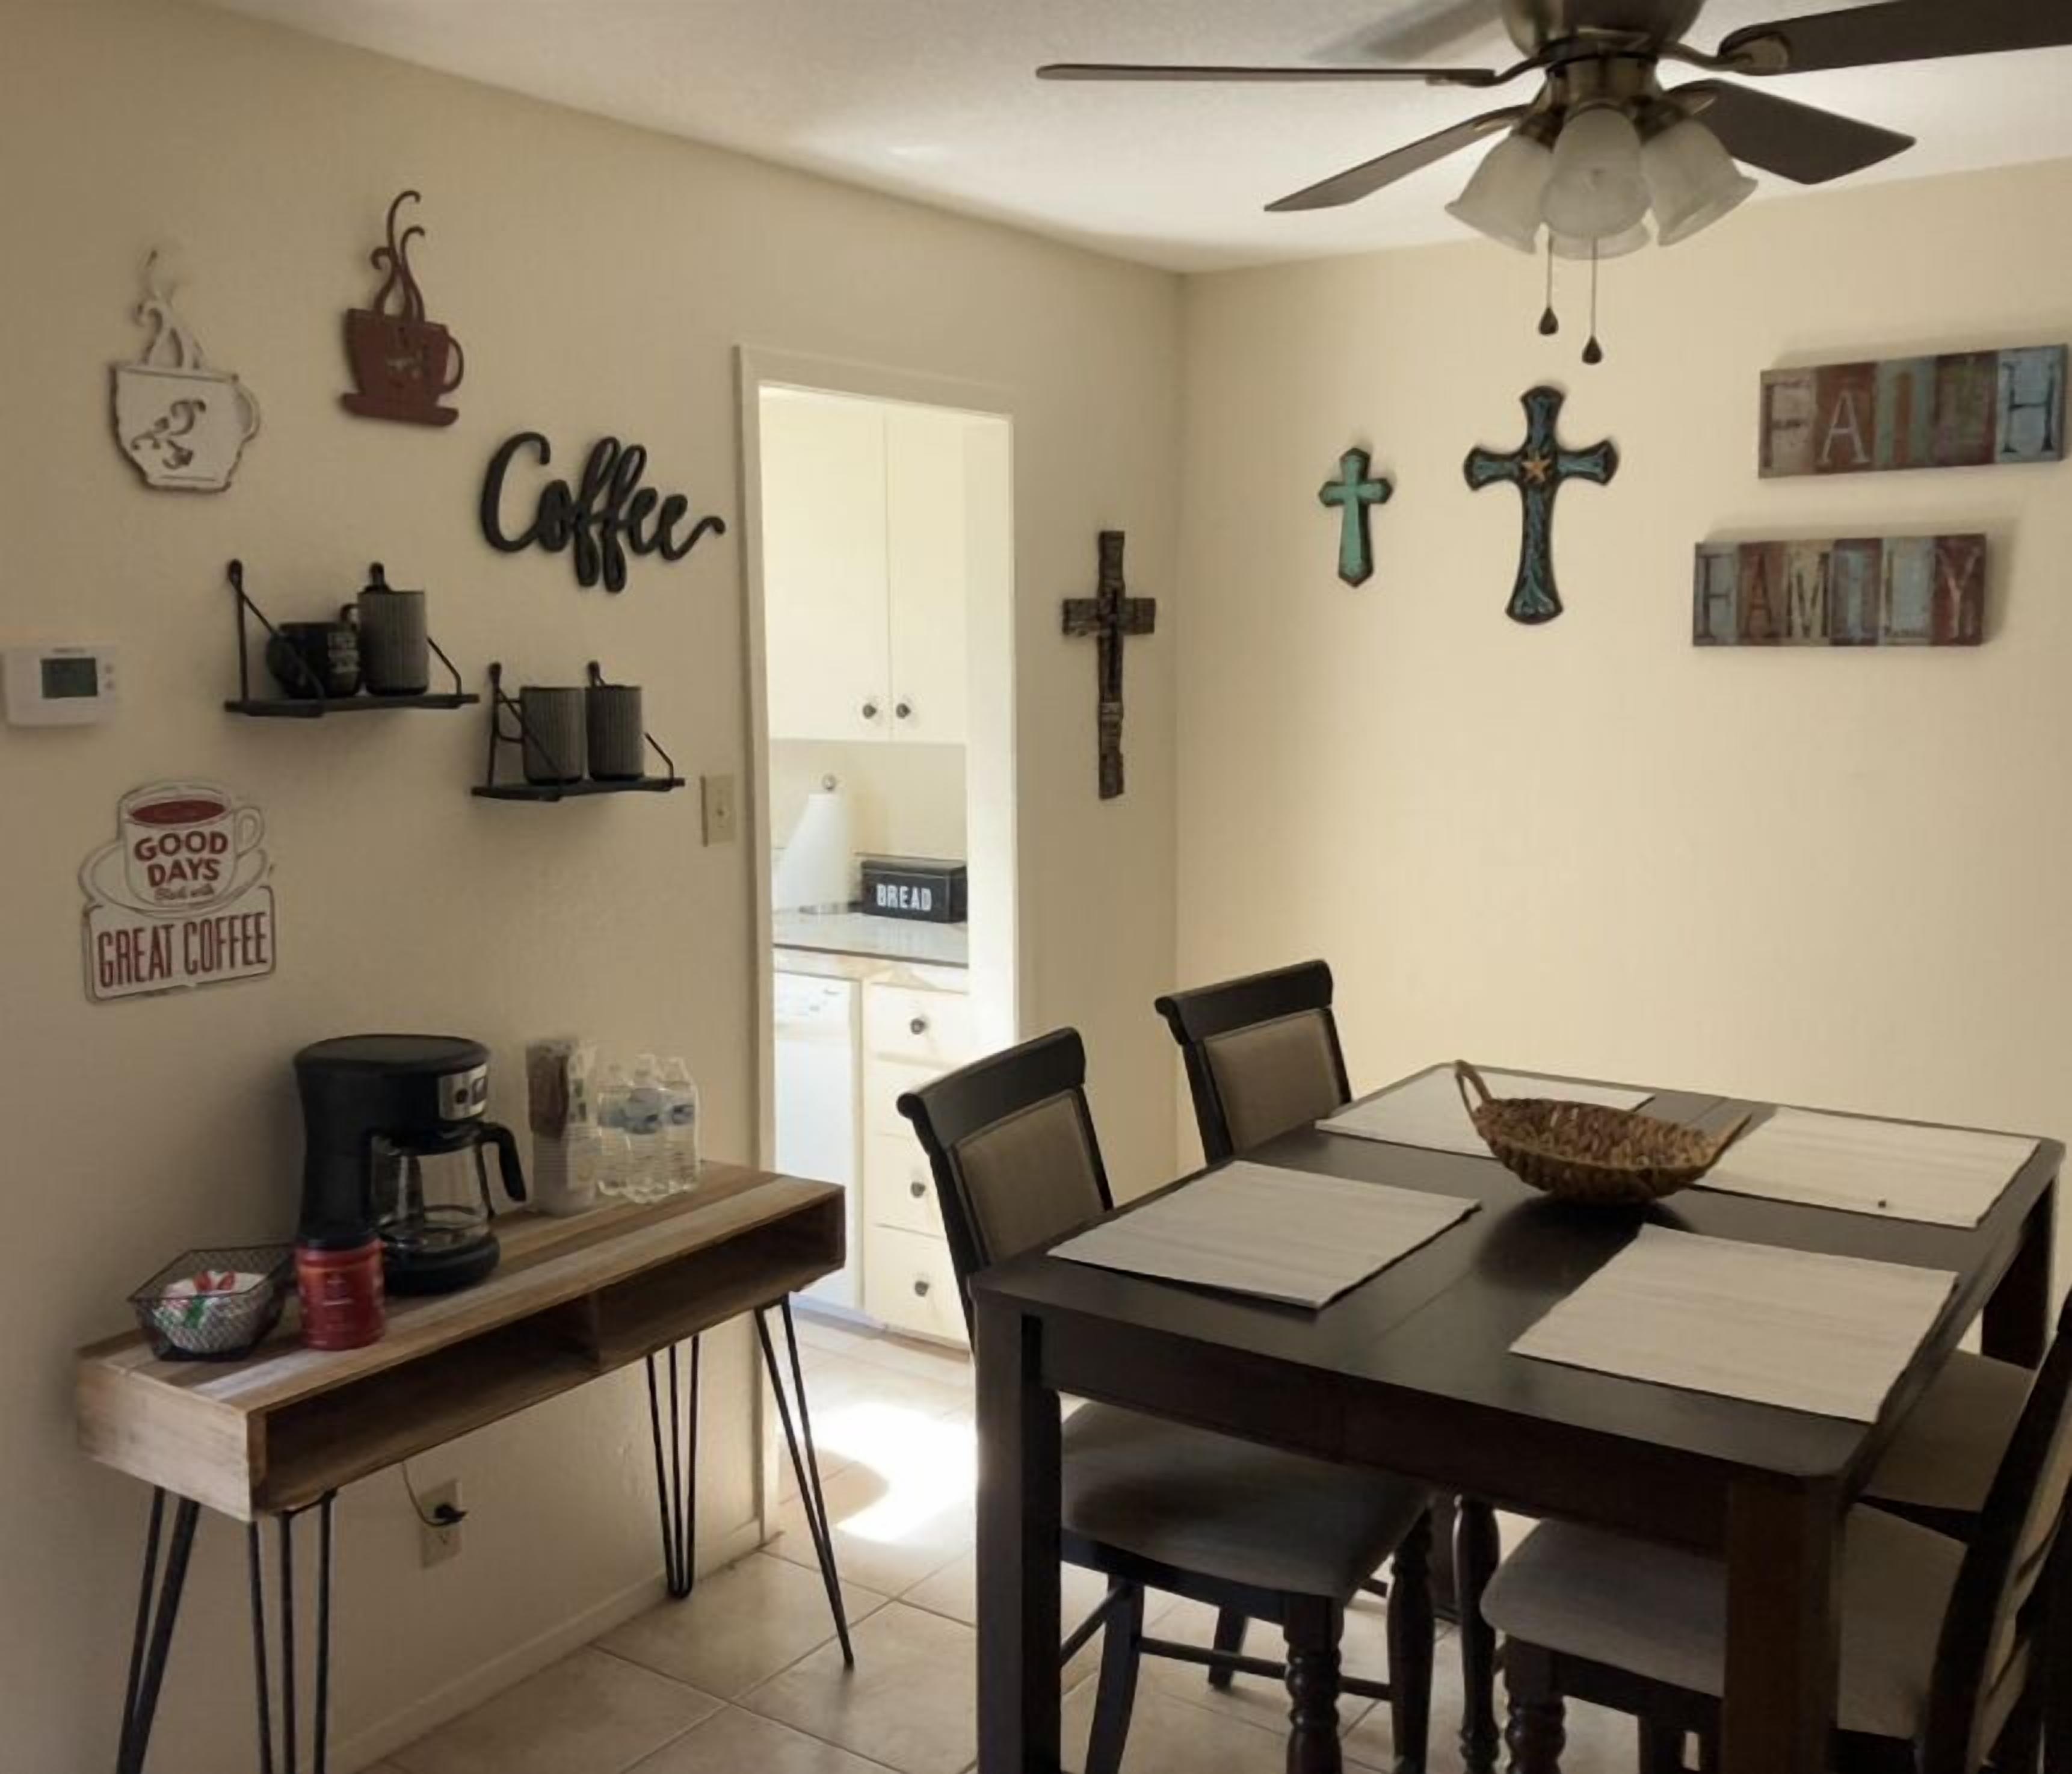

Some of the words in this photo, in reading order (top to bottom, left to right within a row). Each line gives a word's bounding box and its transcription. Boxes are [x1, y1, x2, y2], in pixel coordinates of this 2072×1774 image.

[1760, 360, 2061, 468] FAIH
[481, 431, 726, 593] Coffee
[1697, 546, 1982, 639] FAMILY
[134, 830, 228, 862] GOOD
[147, 858, 220, 887] DAYS
[877, 883, 932, 912] BREAD
[97, 924, 174, 988] GREAT
[183, 912, 267, 975] COFFEE
